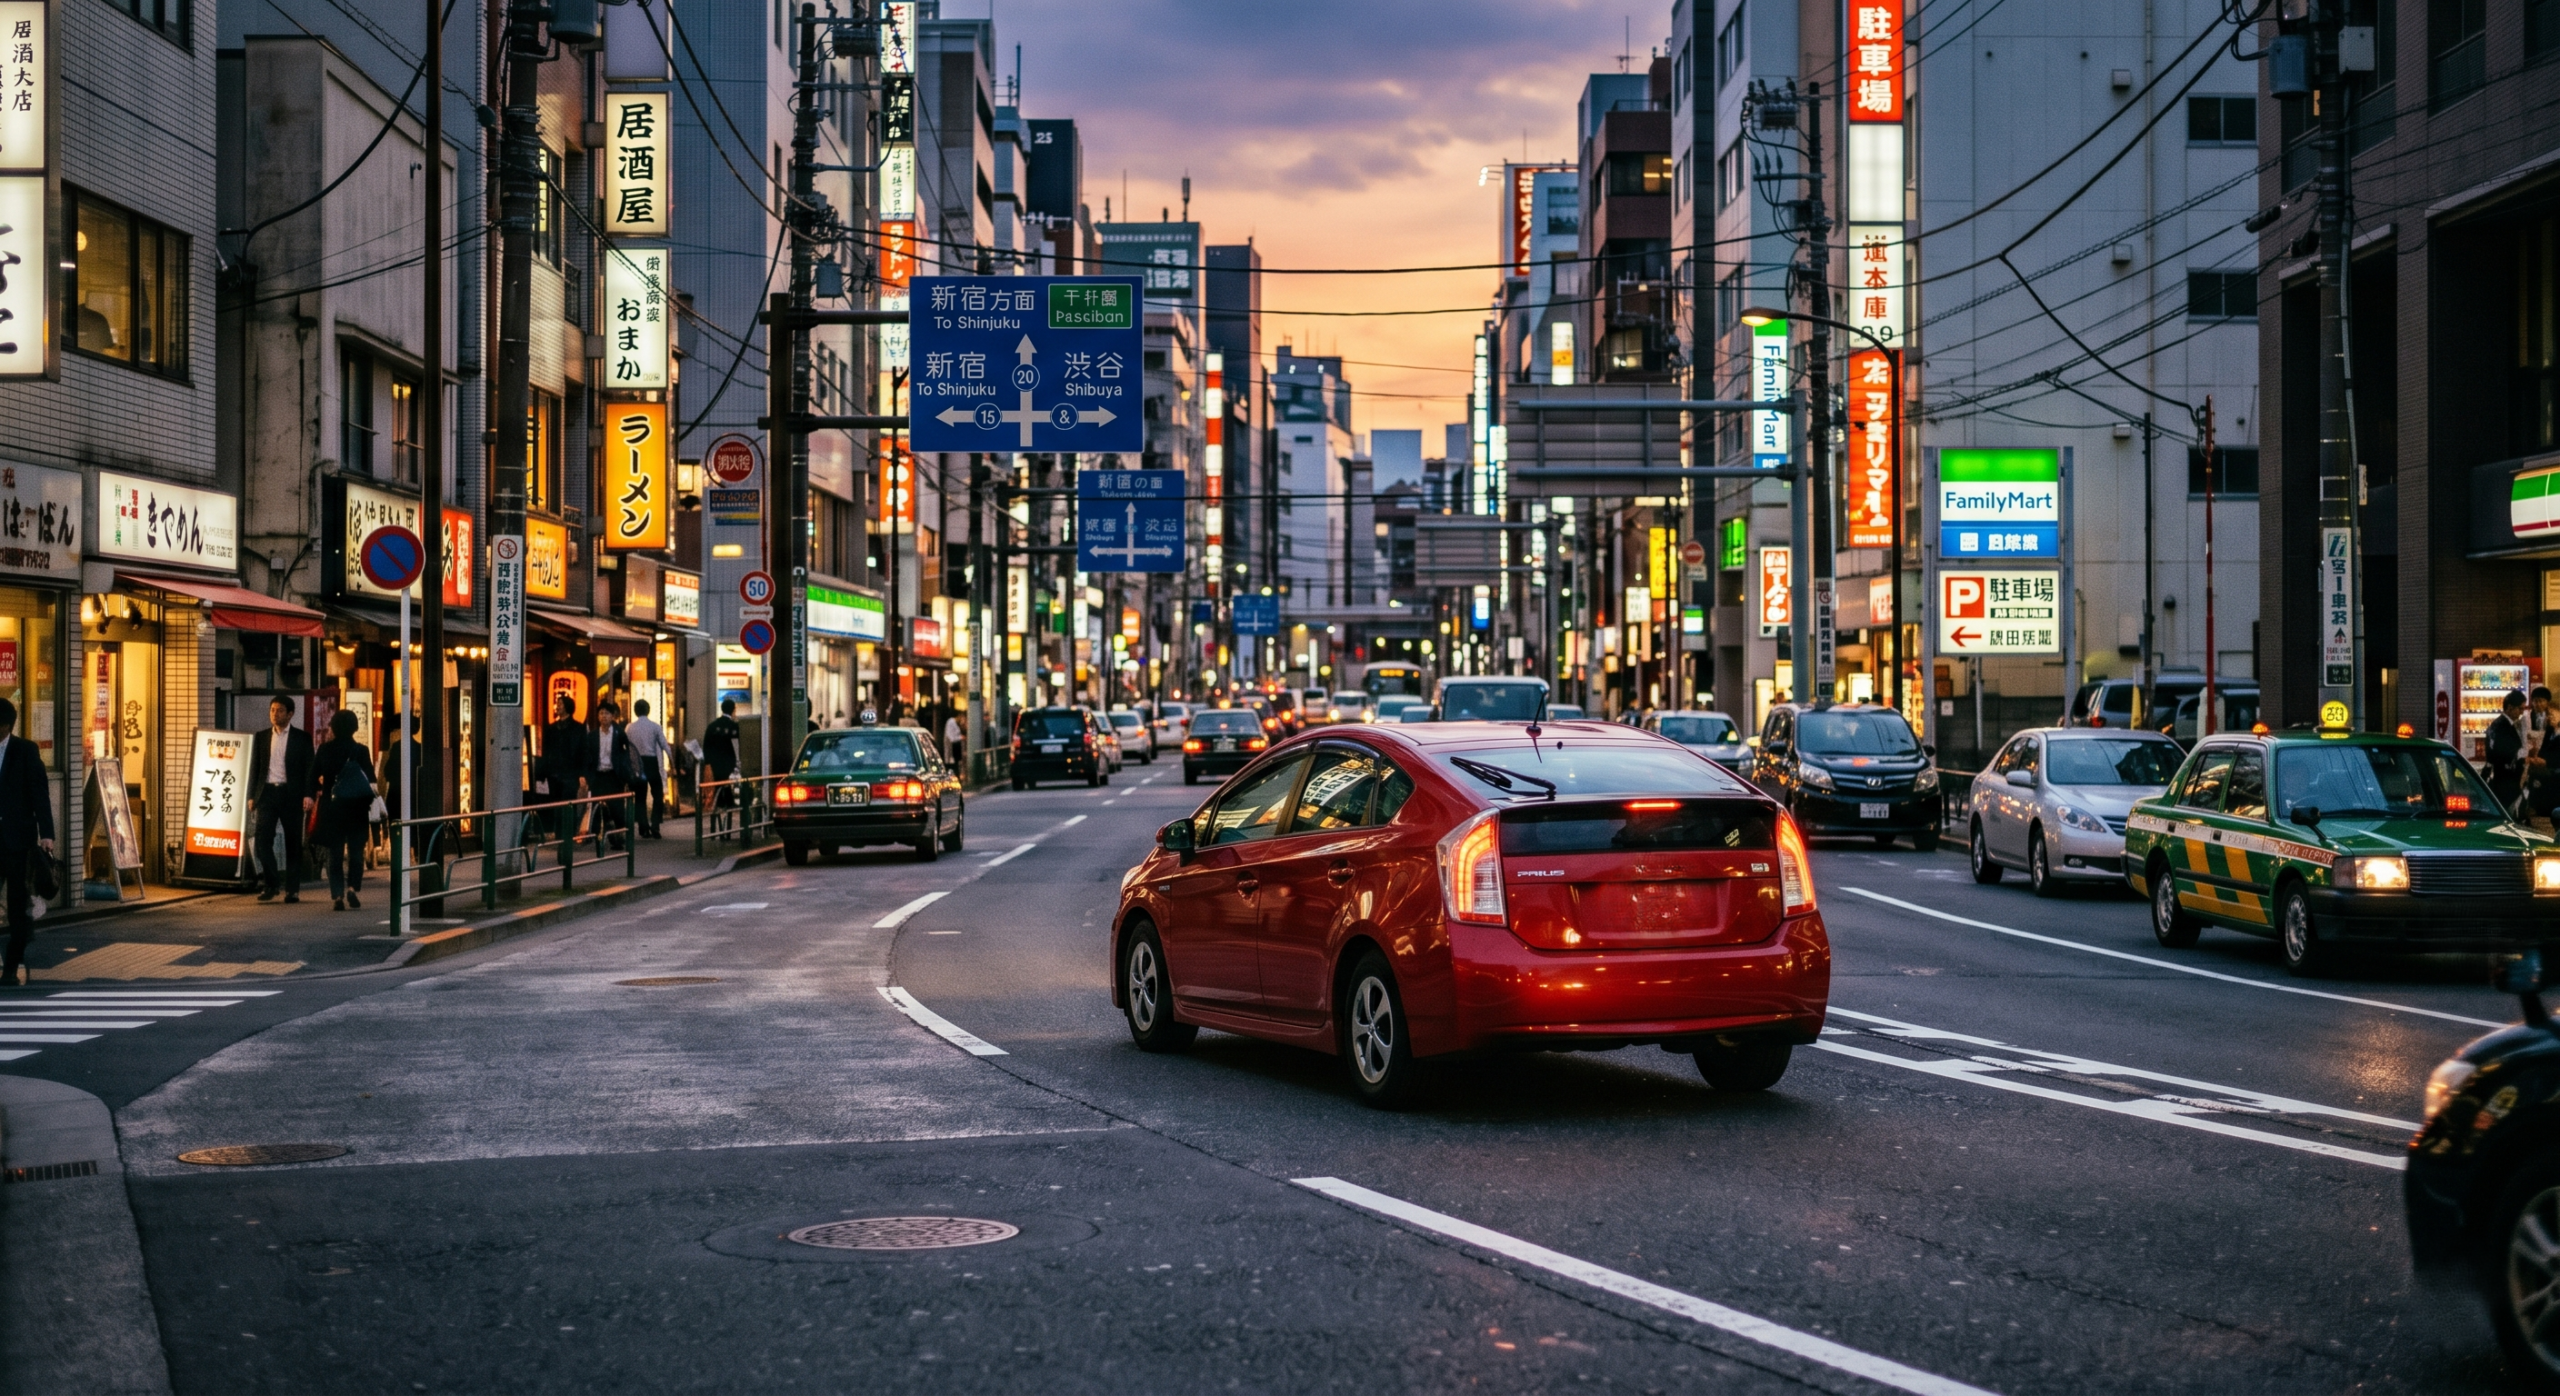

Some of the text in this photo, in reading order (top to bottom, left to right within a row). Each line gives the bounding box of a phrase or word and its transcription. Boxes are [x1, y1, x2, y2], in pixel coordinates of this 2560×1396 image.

[1858, 6, 1893, 113] 駐車場
[616, 103, 655, 223] 居酒屋
[931, 285, 1035, 311] 新宿方面
[934, 316, 1021, 331] To Shinjuku
[616, 297, 641, 381] おまか
[926, 351, 986, 379] 新宿
[1064, 352, 1123, 379] 渋谷
[917, 383, 996, 398] To Shinjuku
[1017, 371, 1034, 385] 20
[1065, 383, 1123, 399] Shibuya
[980, 410, 996, 425] 15
[619, 414, 652, 538] ラーメン
[1945, 492, 2052, 513] FamilyMart
[748, 581, 766, 597] 50
[1950, 580, 1981, 616] P
[1990, 578, 2054, 602] 駐車場
